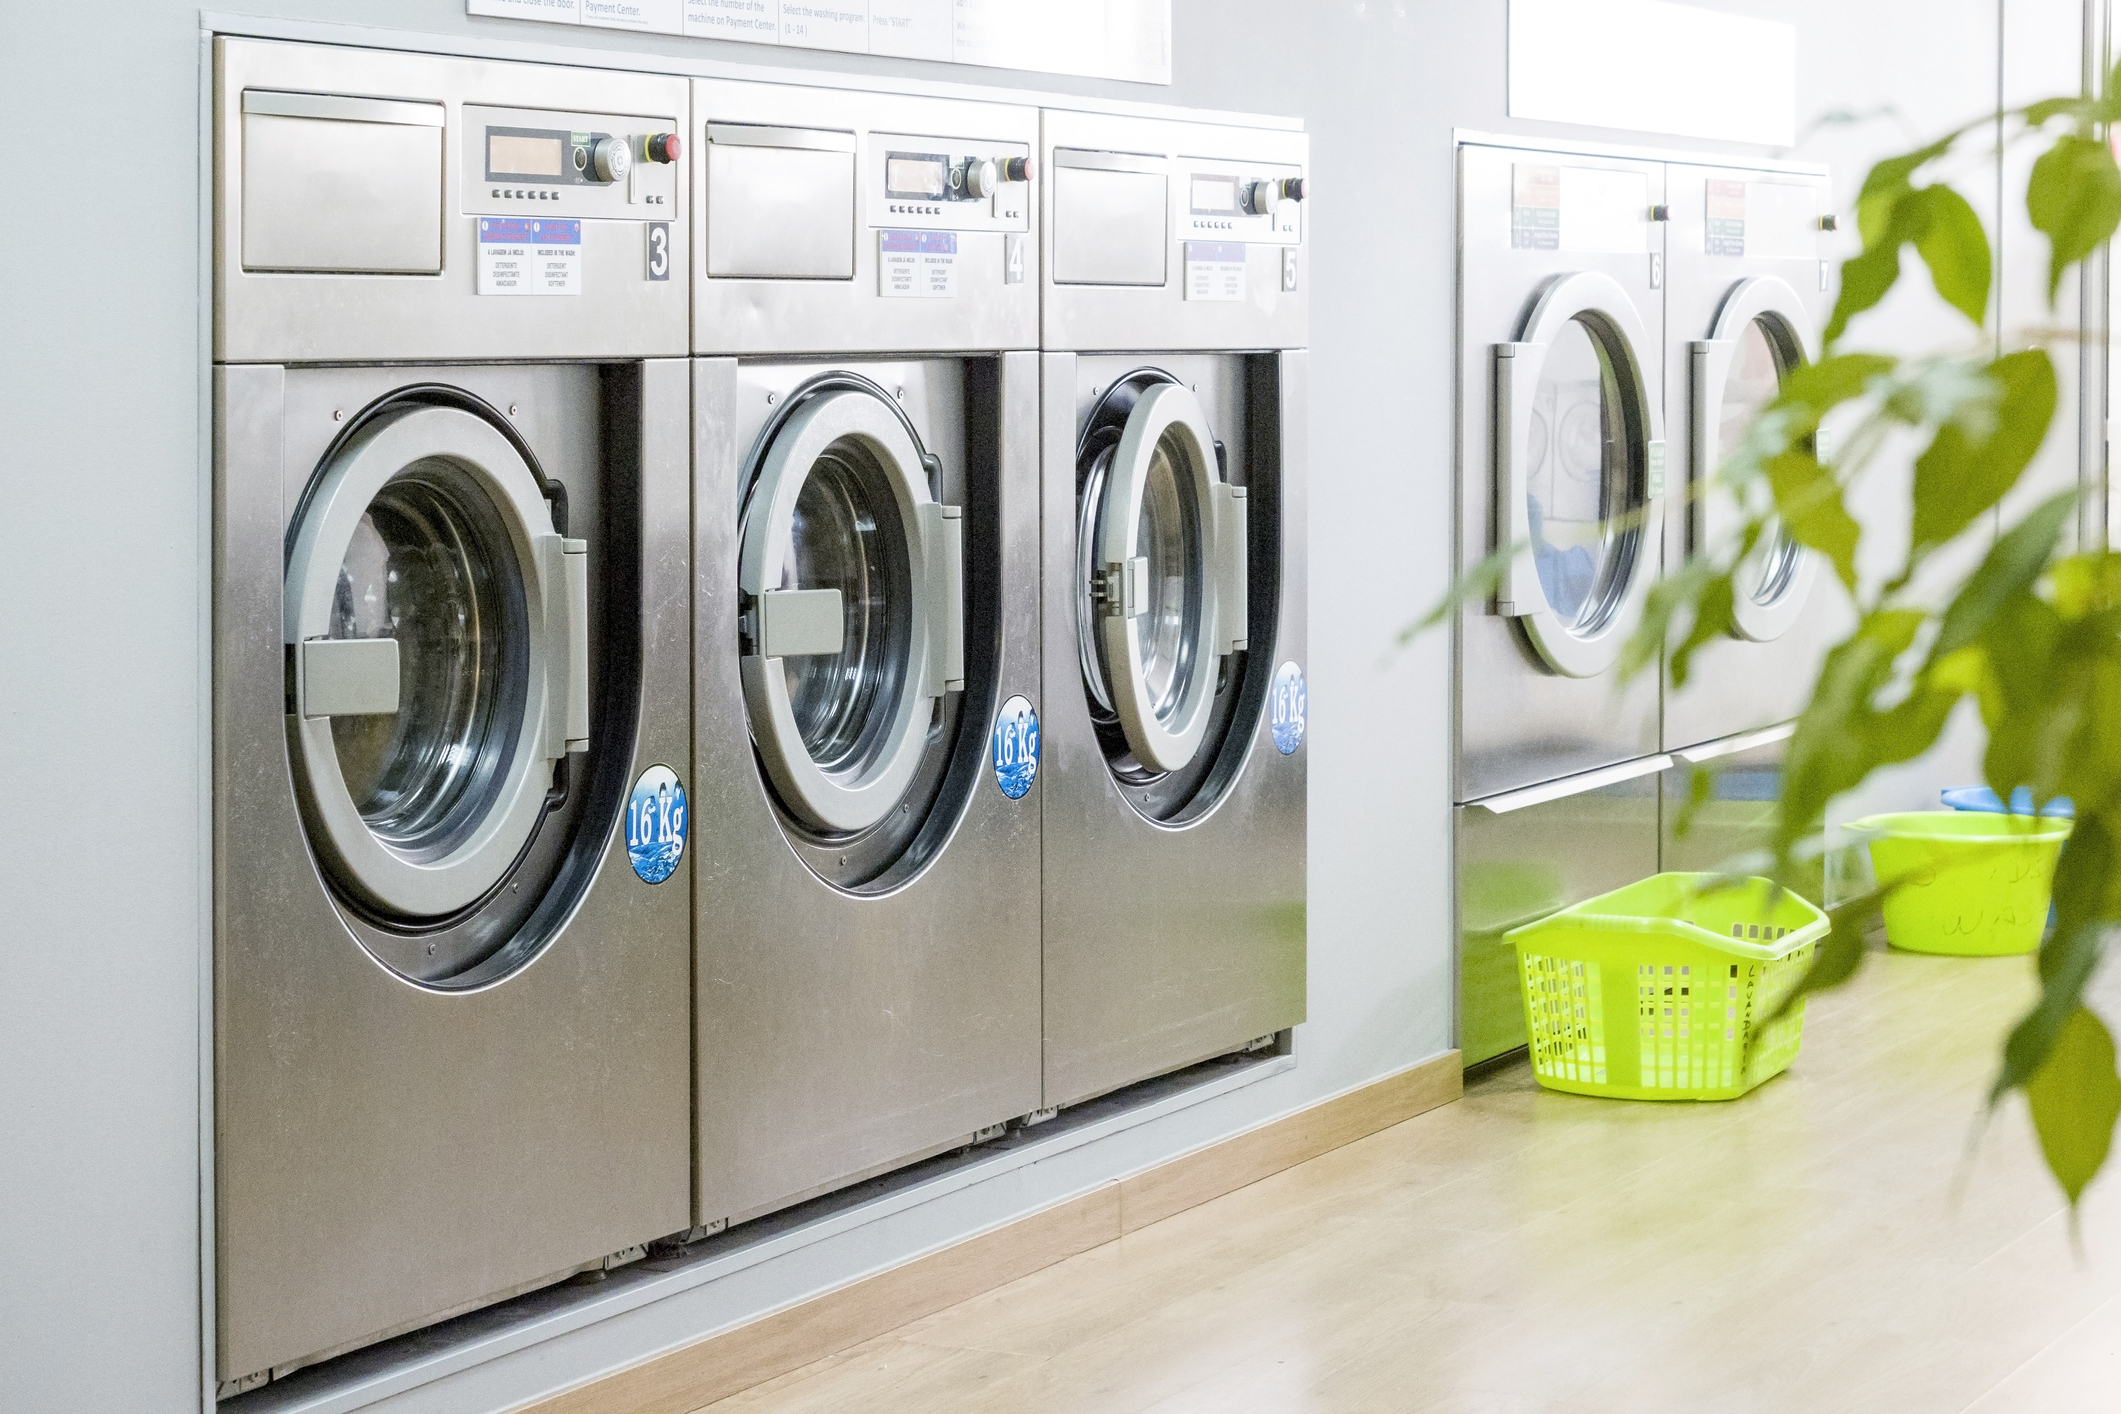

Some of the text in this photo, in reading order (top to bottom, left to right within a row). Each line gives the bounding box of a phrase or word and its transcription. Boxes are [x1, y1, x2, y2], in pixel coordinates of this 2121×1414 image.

[585, 0, 640, 16] Payment Center.
[720, 0, 745, 10] number
[746, 1, 753, 11] of
[754, 1, 765, 12] the
[782, 3, 866, 24] Select the washing program.
[873, 14, 888, 26] Press
[688, 13, 777, 31] machine on Payment Center.
[572, 135, 589, 143] START
[651, 227, 668, 276] 3
[1009, 237, 1023, 281] 4
[1285, 250, 1296, 289] 5
[1652, 254, 1661, 287] 6
[1820, 261, 1829, 290] 7
[1272, 685, 1305, 734] 16 Kg
[996, 722, 1037, 775] 16 Kg
[630, 796, 684, 856] 16 Kg
